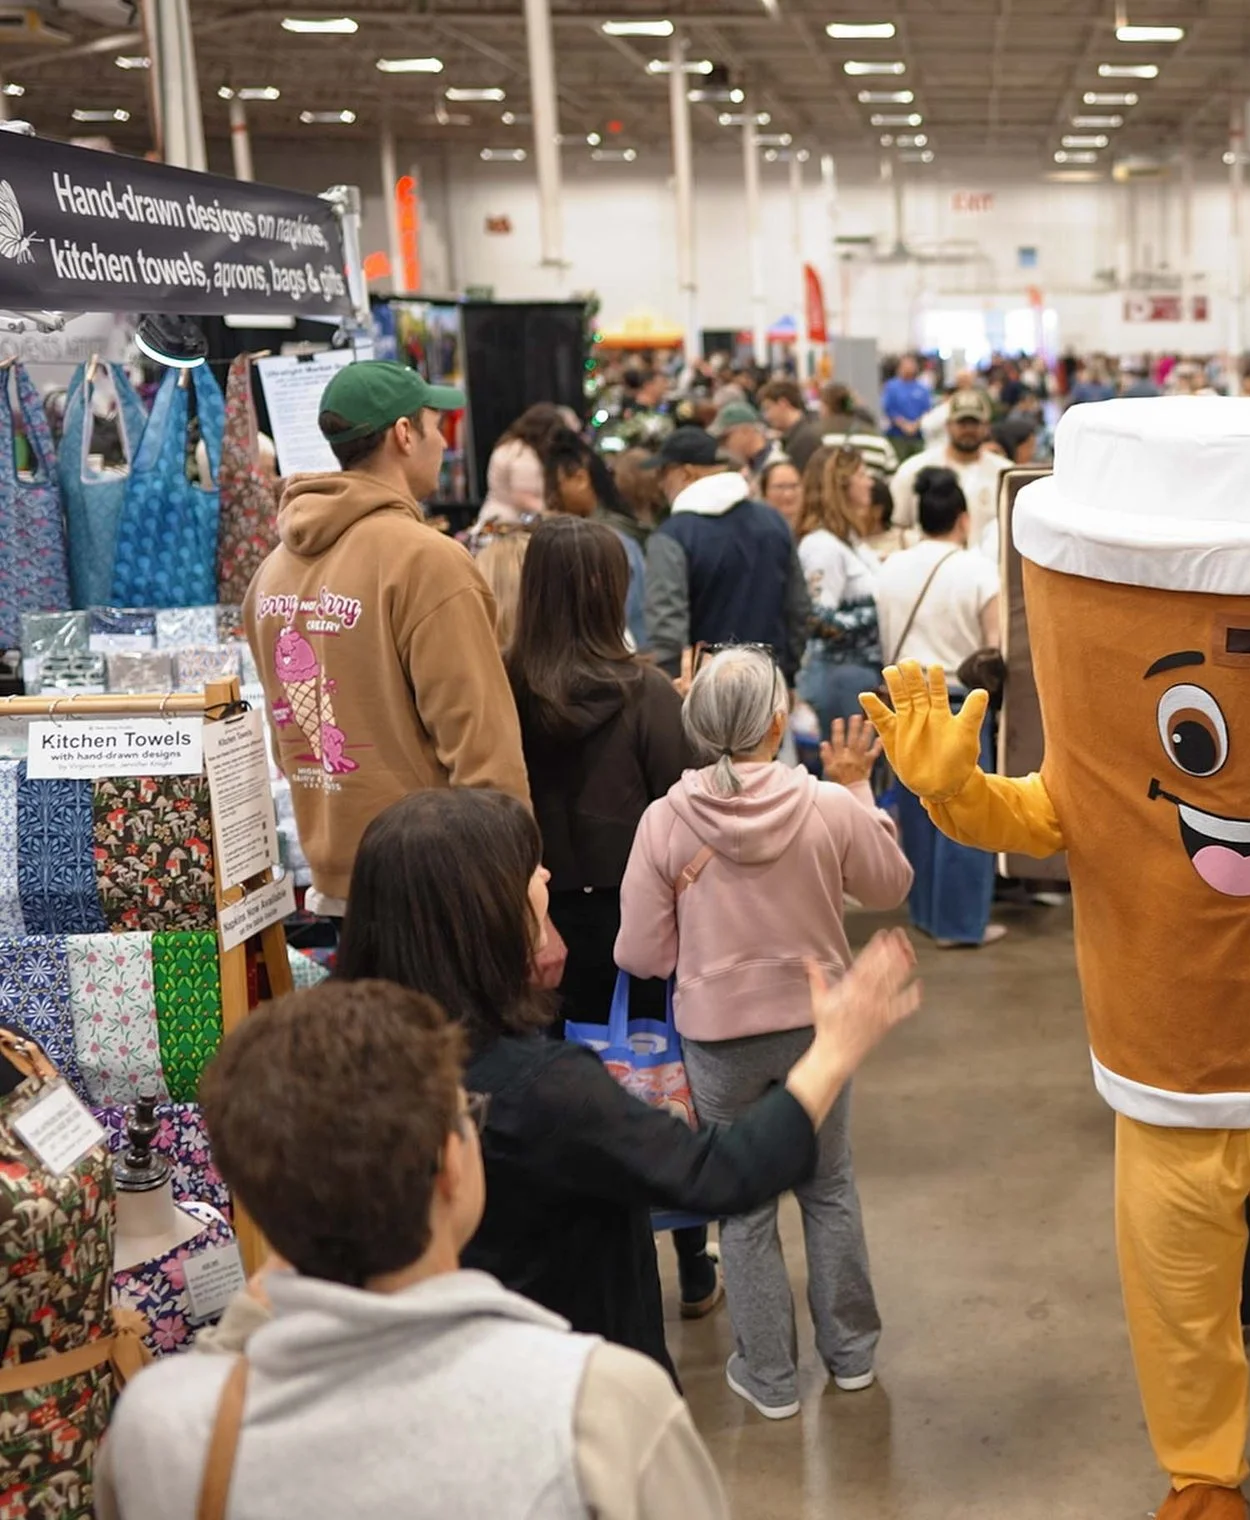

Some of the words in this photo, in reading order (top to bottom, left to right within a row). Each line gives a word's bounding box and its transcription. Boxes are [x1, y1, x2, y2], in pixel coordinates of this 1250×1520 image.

[53, 172, 186, 227] Hand-drawn
[186, 195, 256, 242] designs
[258, 213, 275, 238] on
[275, 215, 329, 252] napkins,
[50, 238, 137, 283] kitchen
[137, 248, 211, 293] towels,
[213, 263, 270, 296] aprons,
[269, 259, 306, 300] bags
[305, 263, 321, 294] &
[42, 733, 117, 749] Kitchen
[124, 731, 191, 747] Towels
[51, 752, 74, 761] with
[77, 750, 139, 760] hand-drawn
[142, 749, 181, 760] designs
